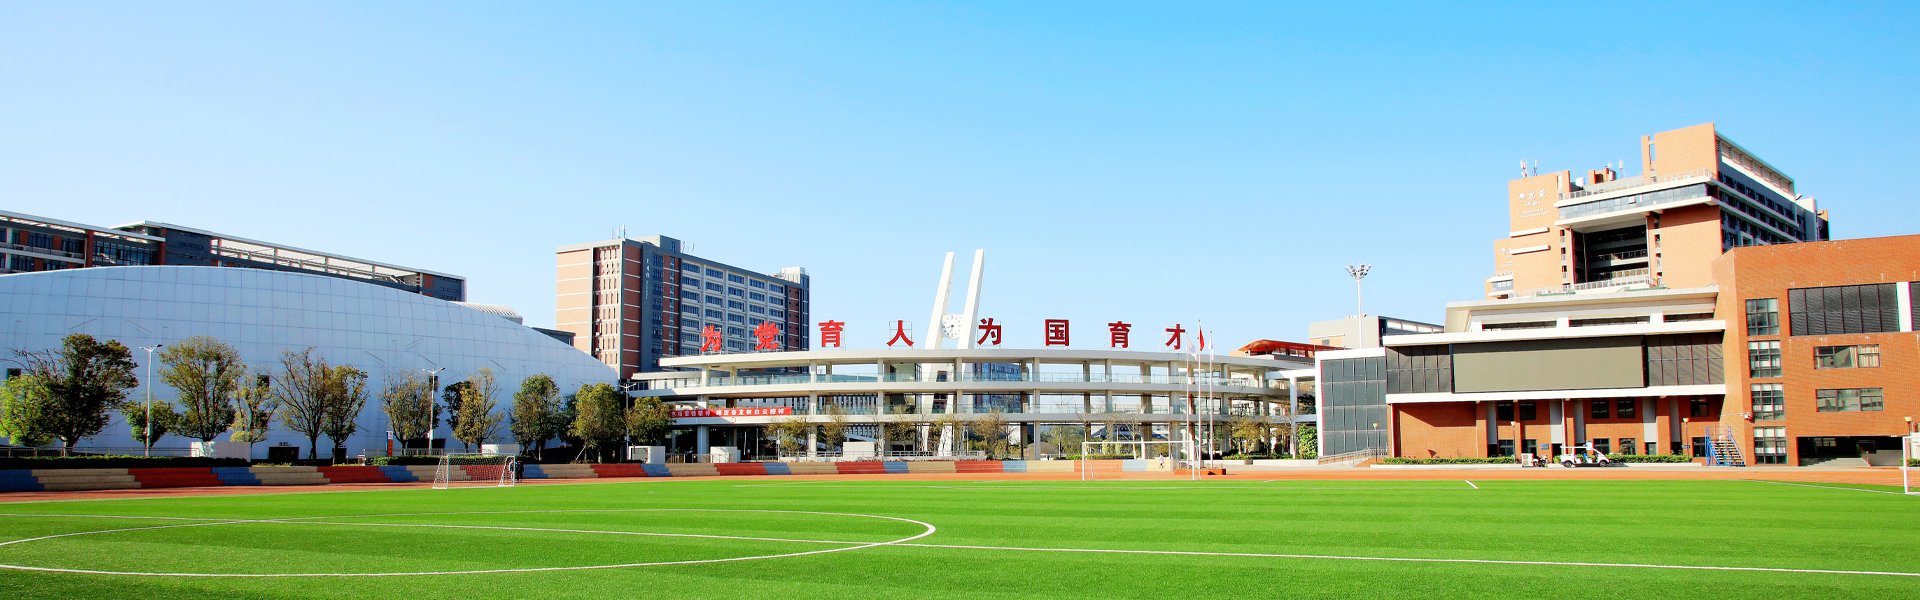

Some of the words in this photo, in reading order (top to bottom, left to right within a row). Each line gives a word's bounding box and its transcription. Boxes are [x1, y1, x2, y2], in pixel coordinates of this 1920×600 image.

[700, 319, 914, 353] 为党育人
[977, 317, 1186, 350] 为国育才
